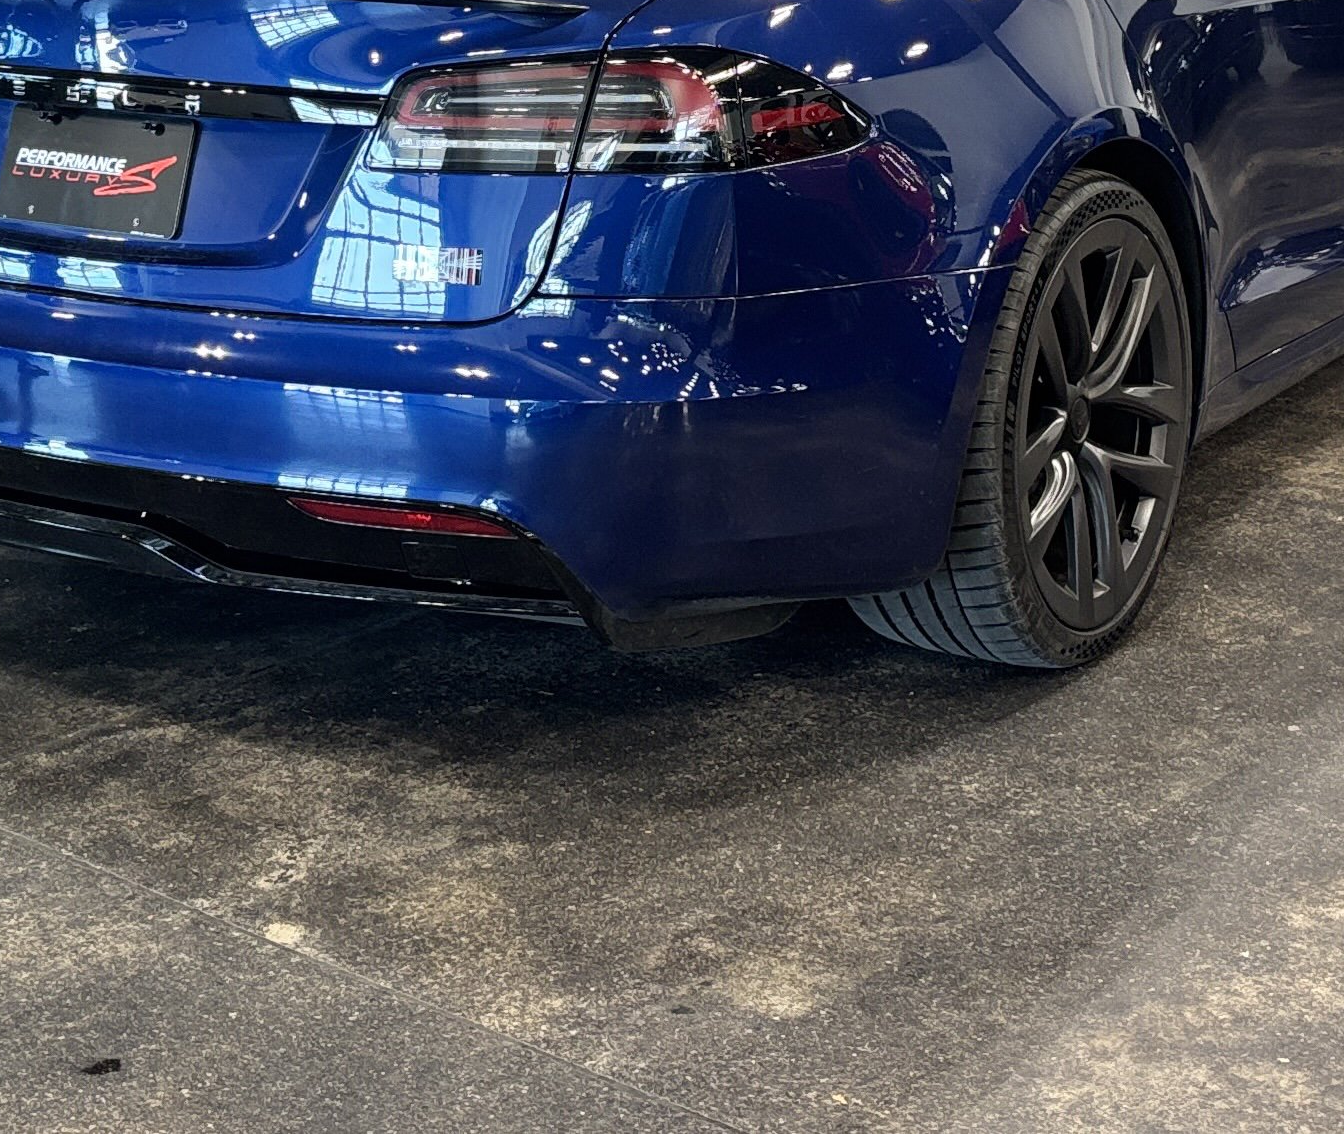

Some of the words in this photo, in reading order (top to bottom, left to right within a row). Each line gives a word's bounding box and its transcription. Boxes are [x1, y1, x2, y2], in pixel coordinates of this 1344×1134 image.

[16, 147, 128, 173] PERFORMANCE
[12, 165, 118, 185] LUXURY
[1012, 342, 1023, 386] PILOT
